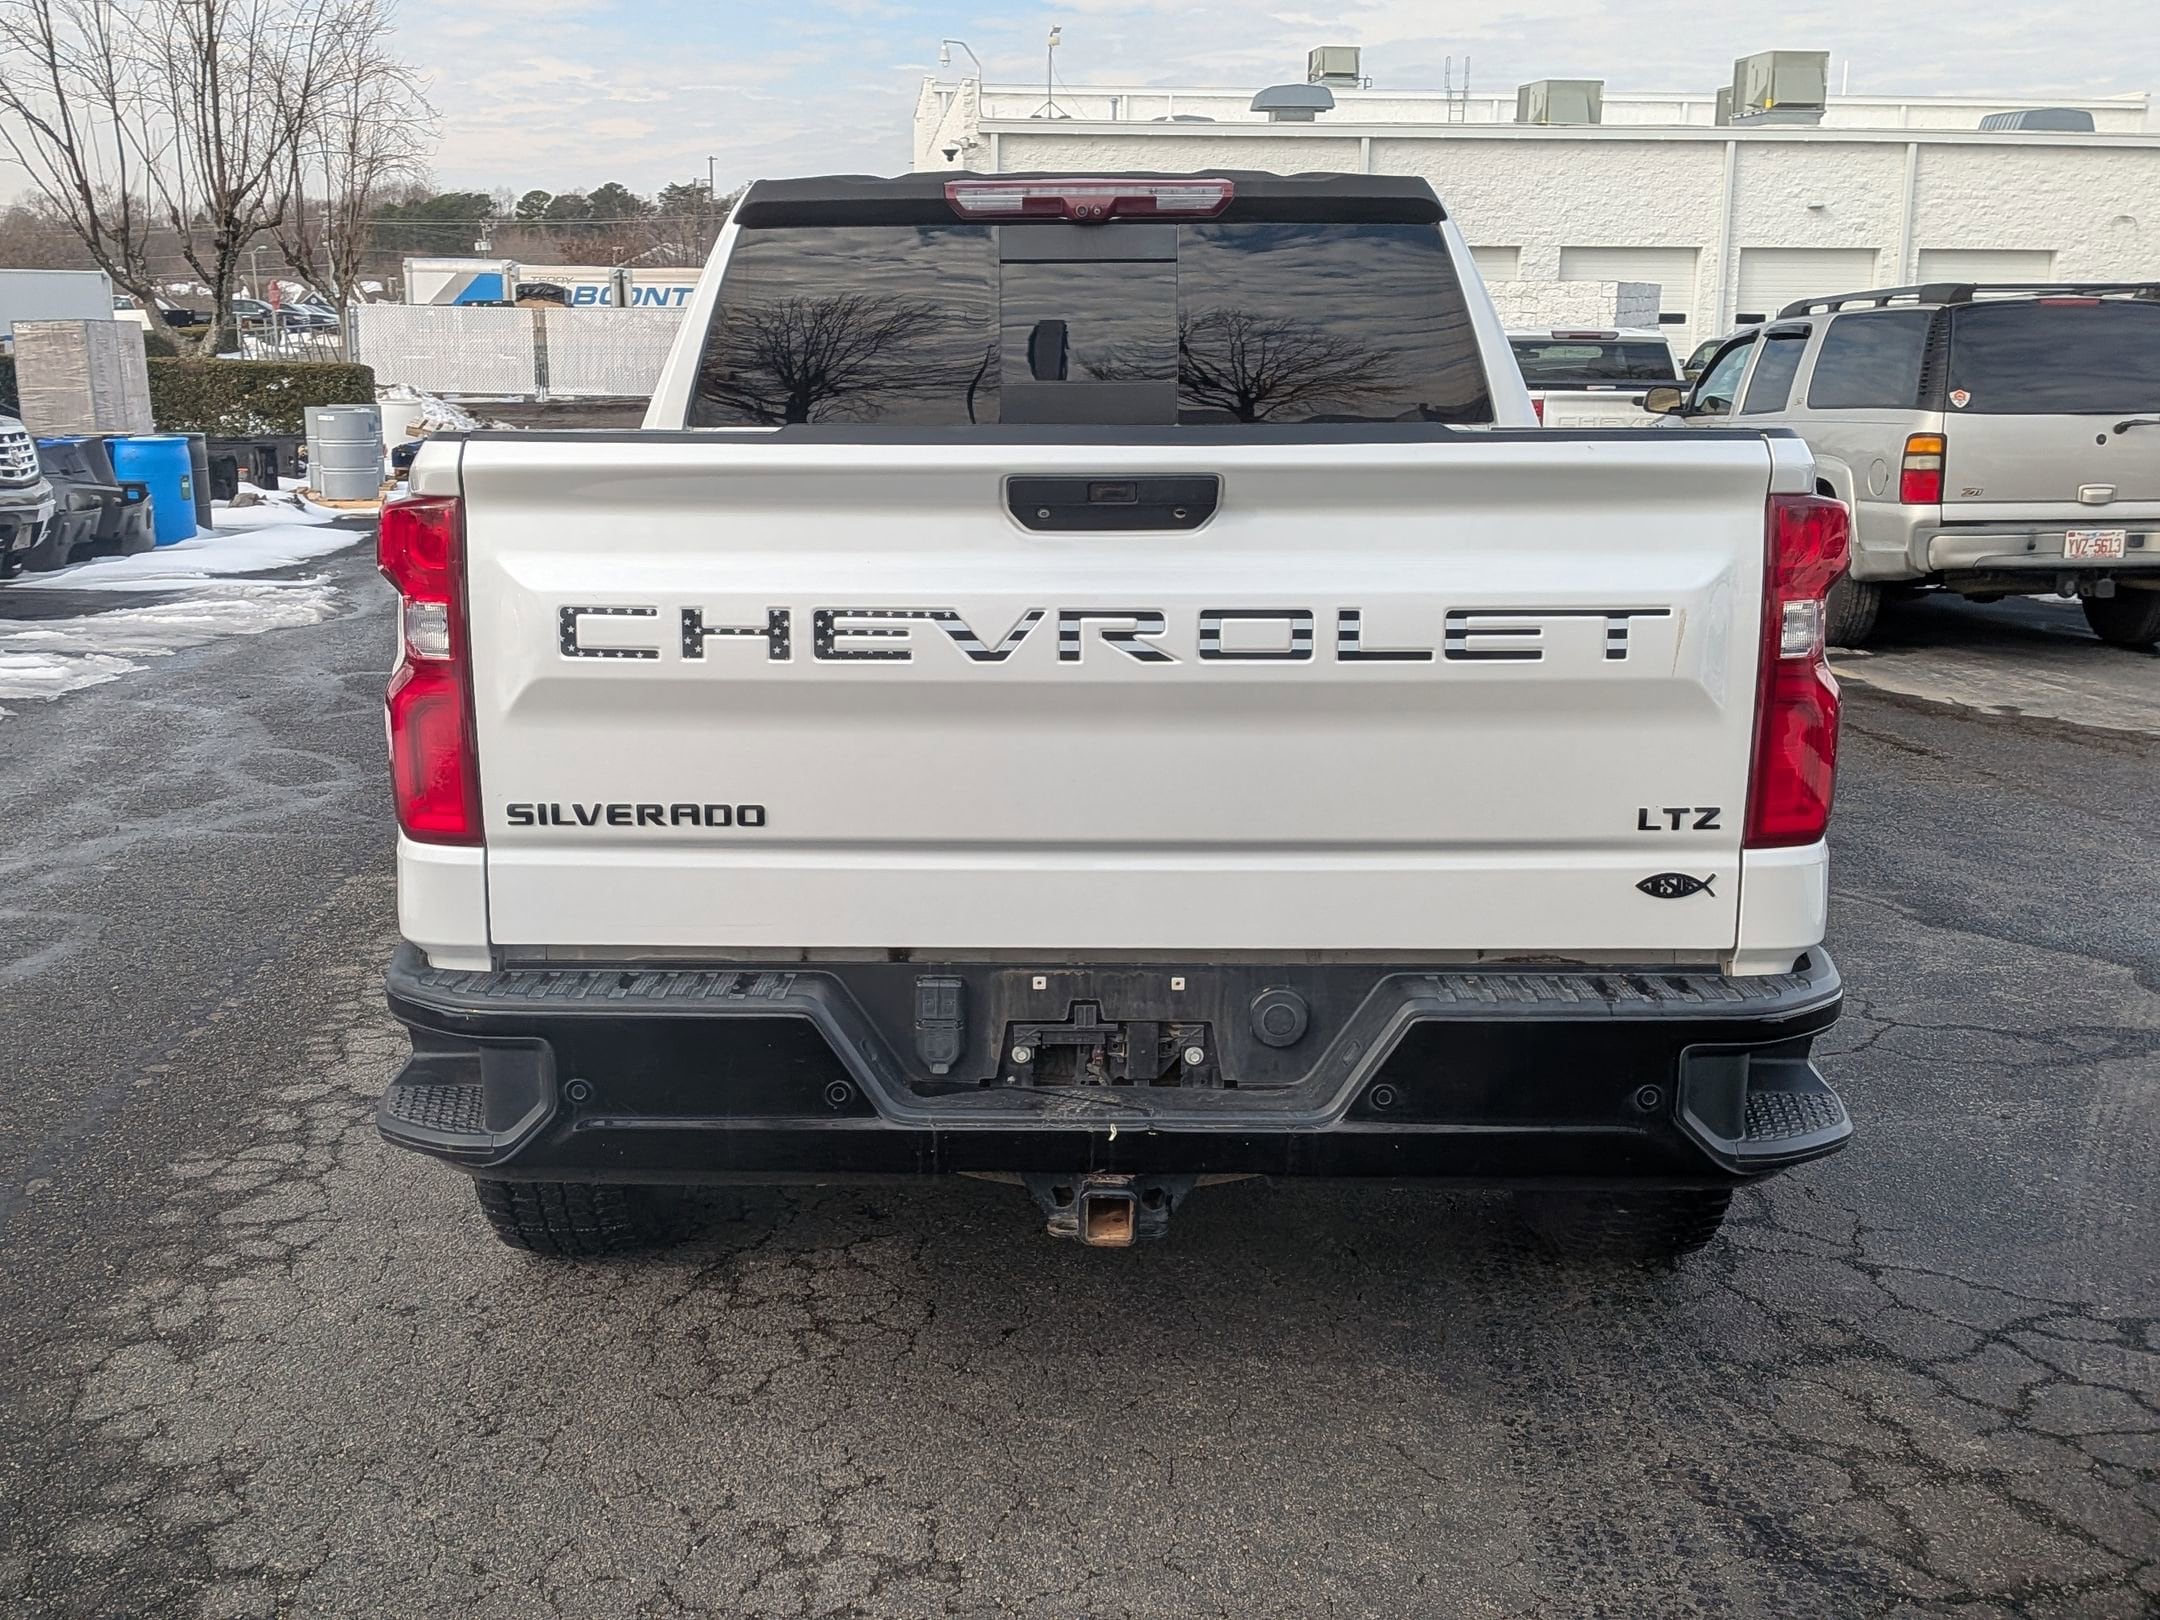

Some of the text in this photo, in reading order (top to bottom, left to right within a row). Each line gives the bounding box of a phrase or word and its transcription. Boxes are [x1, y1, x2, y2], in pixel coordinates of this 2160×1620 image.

[559, 606, 1672, 663] CHEVROLET
[506, 803, 766, 827] SILVERADO
[1637, 807, 1721, 831] LTZ
